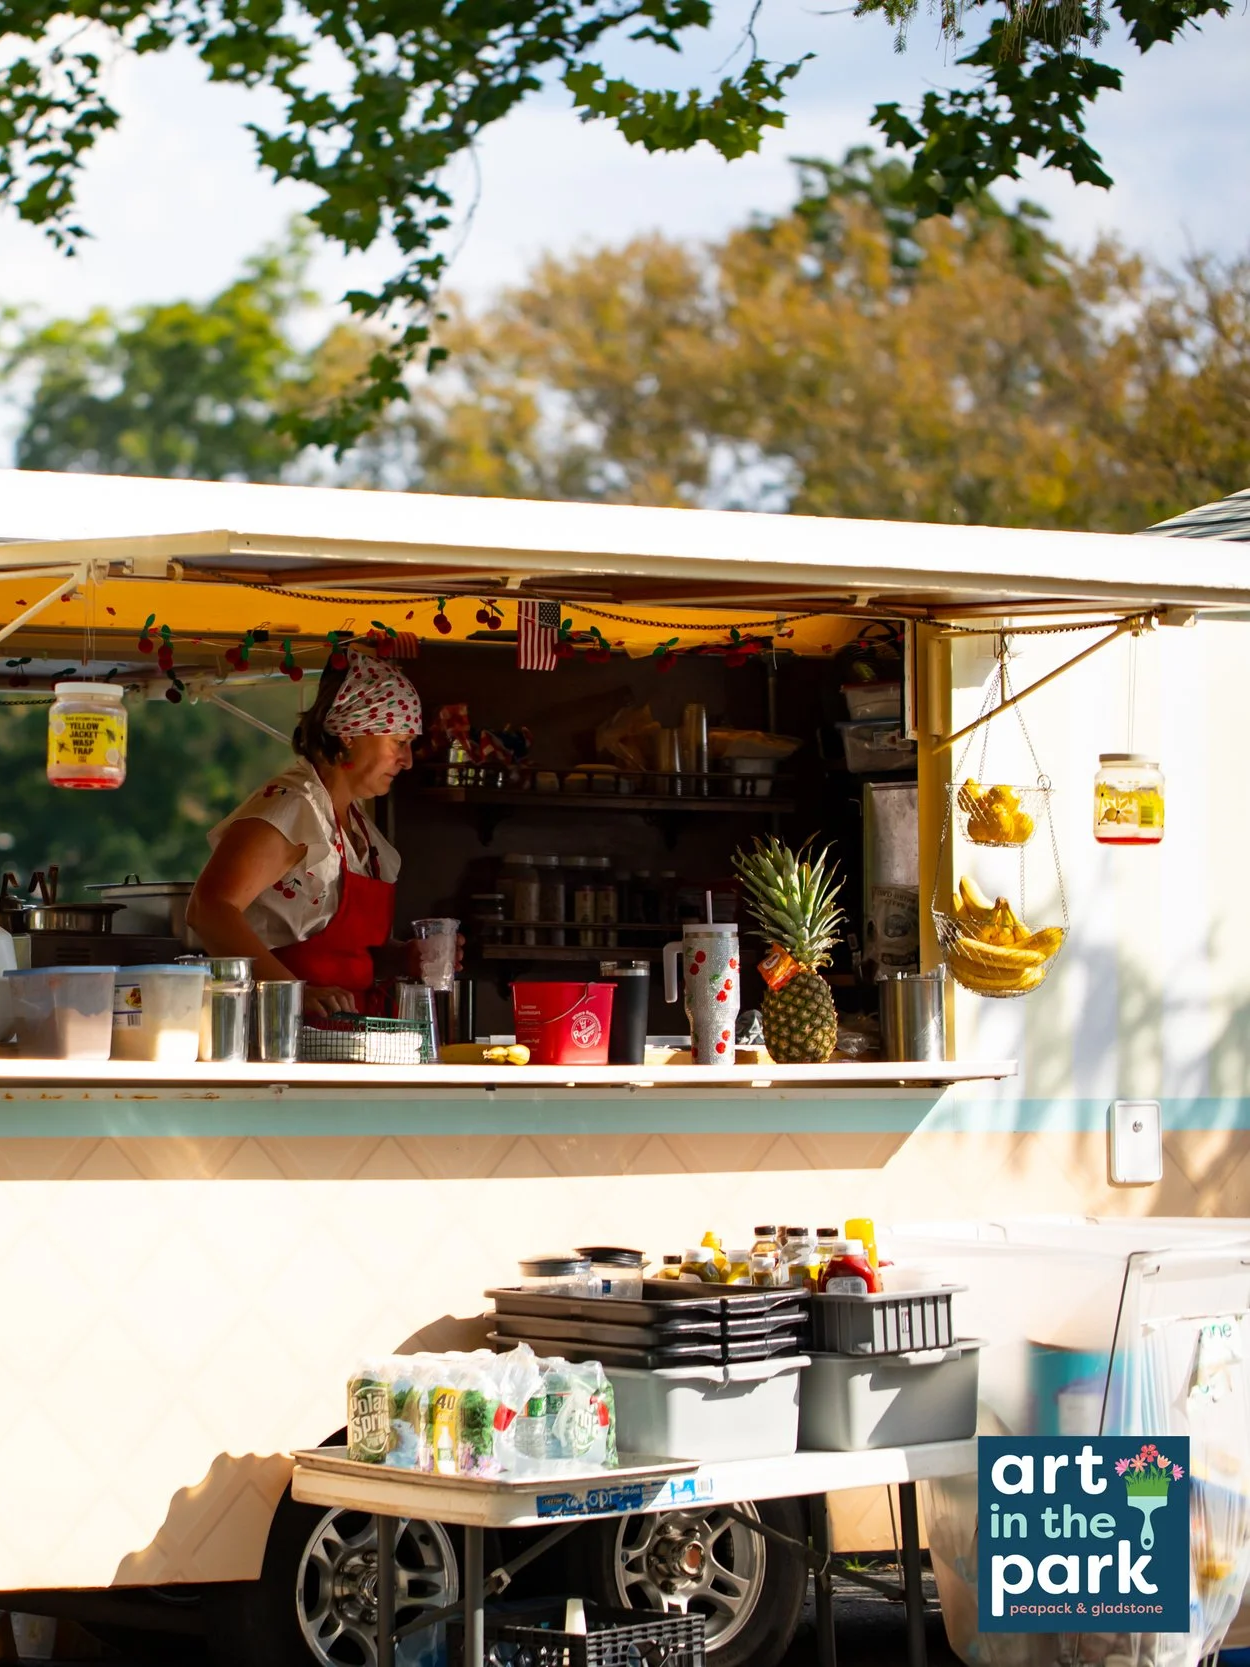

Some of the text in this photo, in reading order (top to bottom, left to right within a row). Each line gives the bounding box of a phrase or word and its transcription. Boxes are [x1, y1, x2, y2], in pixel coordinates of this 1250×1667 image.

[70, 722, 99, 730] YELLOW
[69, 731, 98, 739] JACKET
[73, 747, 94, 755] TRAP
[435, 1393, 456, 1410] 40
